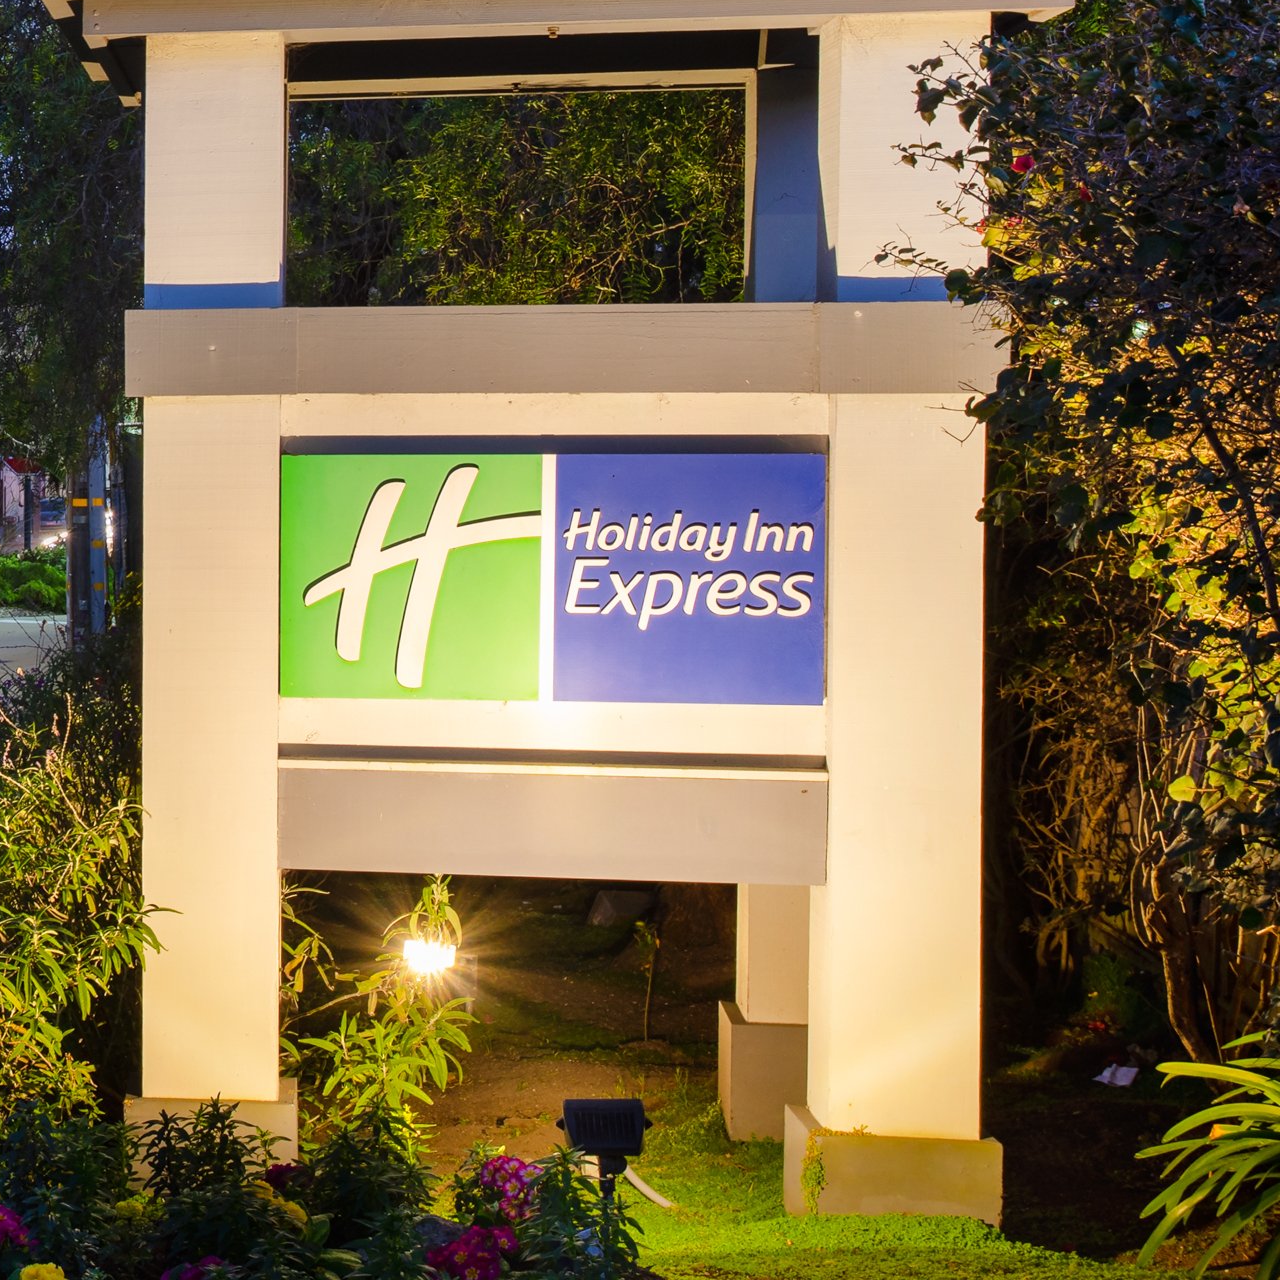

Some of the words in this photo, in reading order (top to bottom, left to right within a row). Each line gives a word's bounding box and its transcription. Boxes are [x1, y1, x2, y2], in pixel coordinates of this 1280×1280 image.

[563, 507, 738, 562] Holiday
[742, 508, 815, 553] Inn
[563, 556, 815, 632] Express
